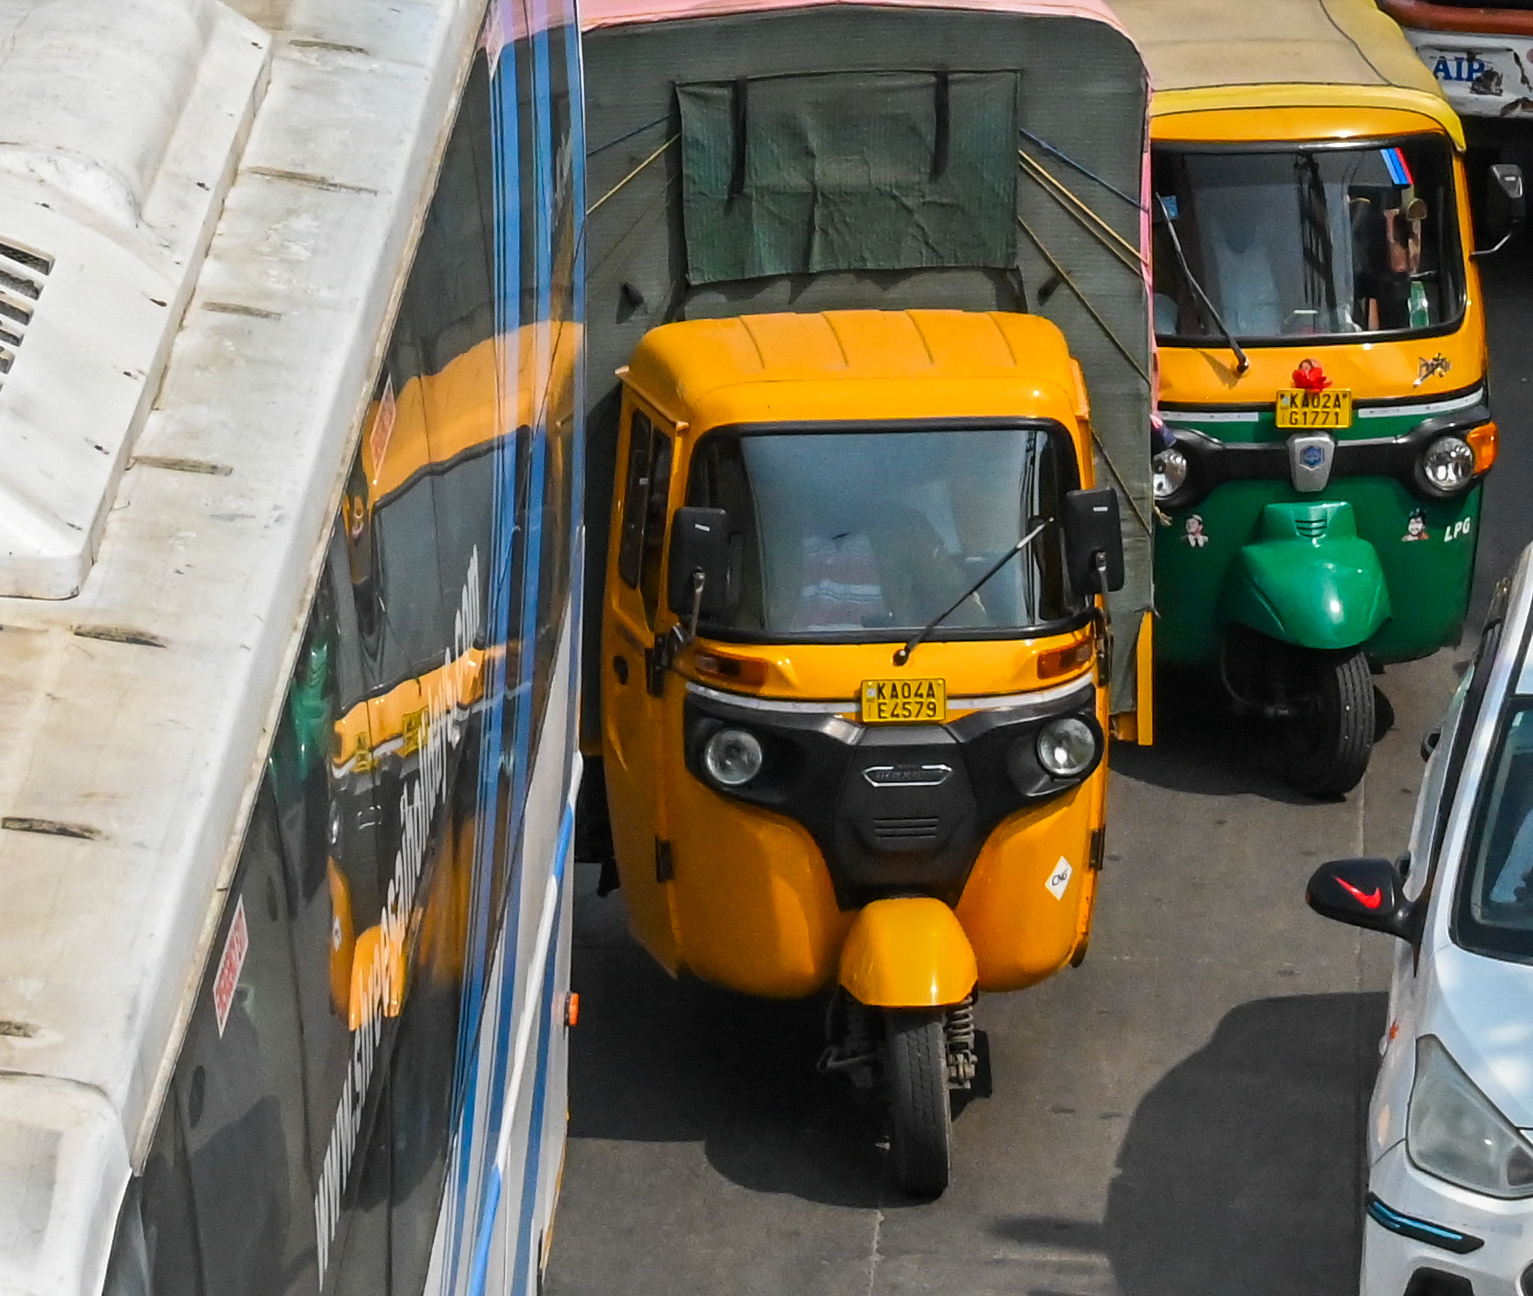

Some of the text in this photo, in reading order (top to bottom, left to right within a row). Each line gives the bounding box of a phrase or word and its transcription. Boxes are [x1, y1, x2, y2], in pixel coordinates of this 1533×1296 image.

[1432, 55, 1487, 83] AIP
[1289, 393, 1342, 409] KA02A
[1289, 410, 1340, 426] G1771
[1443, 516, 1471, 543] LPG
[877, 682, 936, 699] KA04A
[877, 700, 937, 720] E4579
